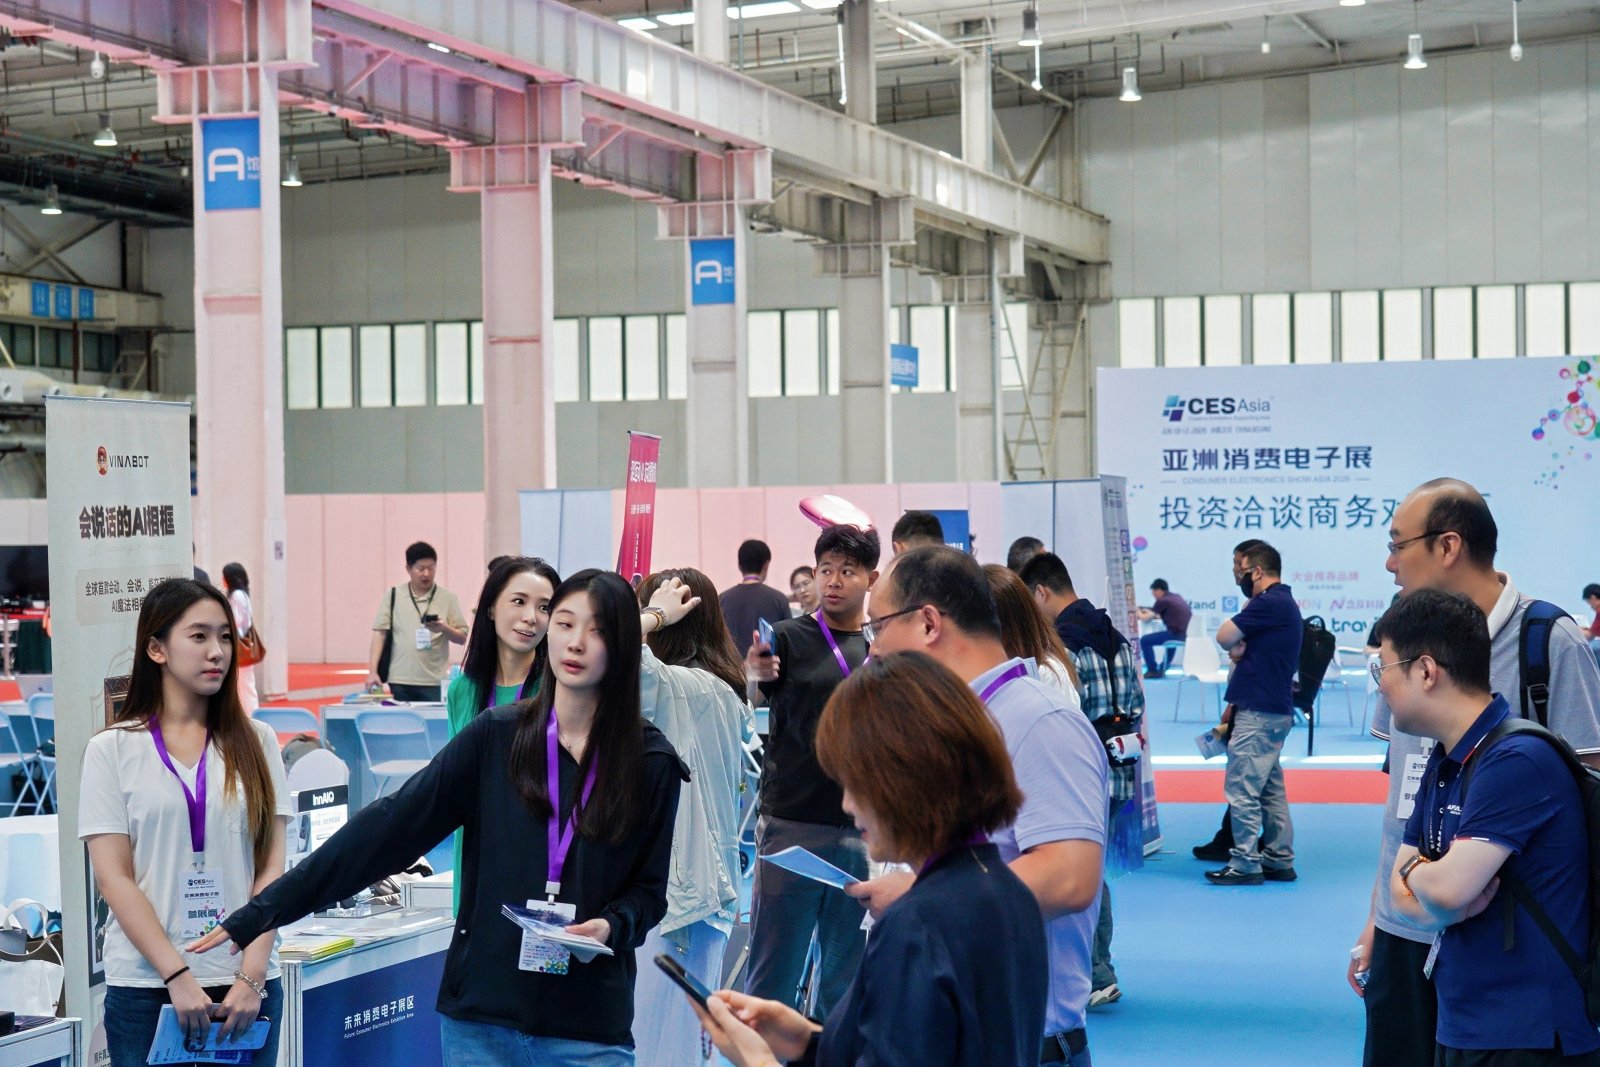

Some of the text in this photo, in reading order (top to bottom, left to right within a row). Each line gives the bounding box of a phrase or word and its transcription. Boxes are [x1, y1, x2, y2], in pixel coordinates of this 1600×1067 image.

[208, 148, 245, 182] A
[695, 260, 722, 285] A
[1188, 398, 1271, 415] CES Asia
[109, 455, 149, 468] VINABOT
[1163, 446, 1372, 471] 亚洲消费电子展
[1182, 477, 1227, 485] CONSUMER
[1229, 476, 1284, 485] ELECTRONICS
[79, 504, 175, 540] 会说话的AI相框
[344, 995, 414, 1031] 未来消费电子展区
